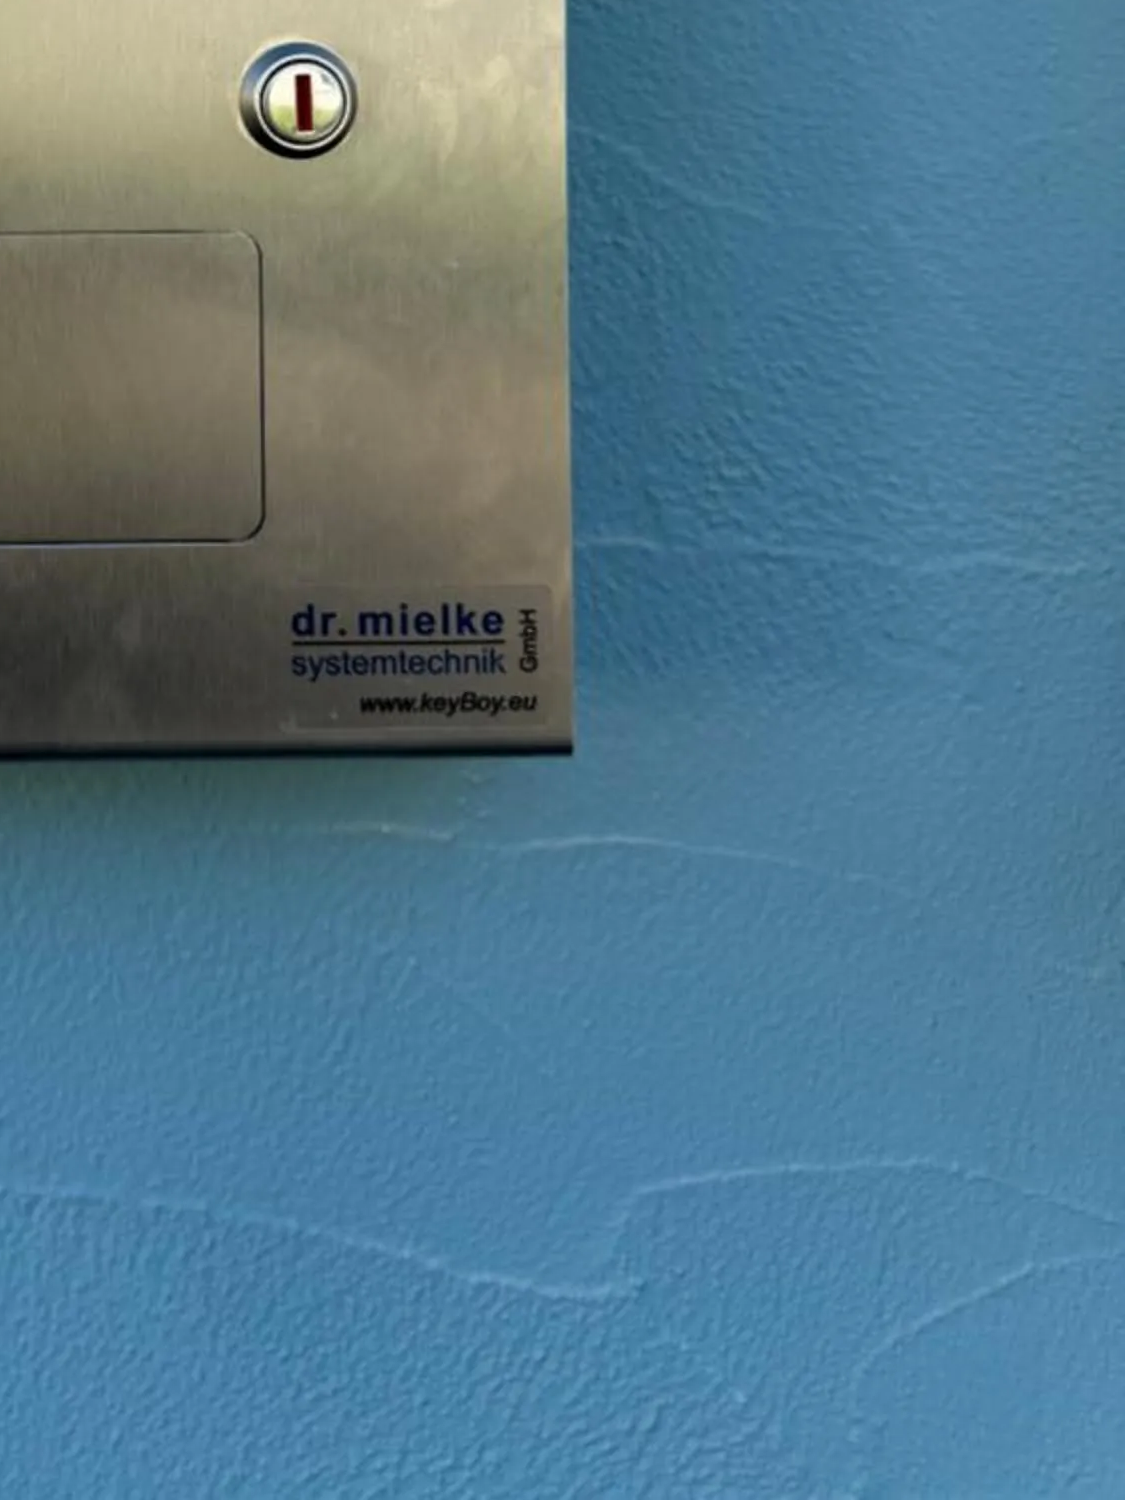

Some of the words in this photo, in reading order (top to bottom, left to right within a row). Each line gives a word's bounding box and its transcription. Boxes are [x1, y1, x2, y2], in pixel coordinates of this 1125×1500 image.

[291, 602, 348, 637] dr.
[358, 602, 505, 637] mielke
[519, 608, 538, 673] GmbH
[291, 648, 506, 683] systemtechnik
[360, 691, 538, 717] www.keyBoy.eu
